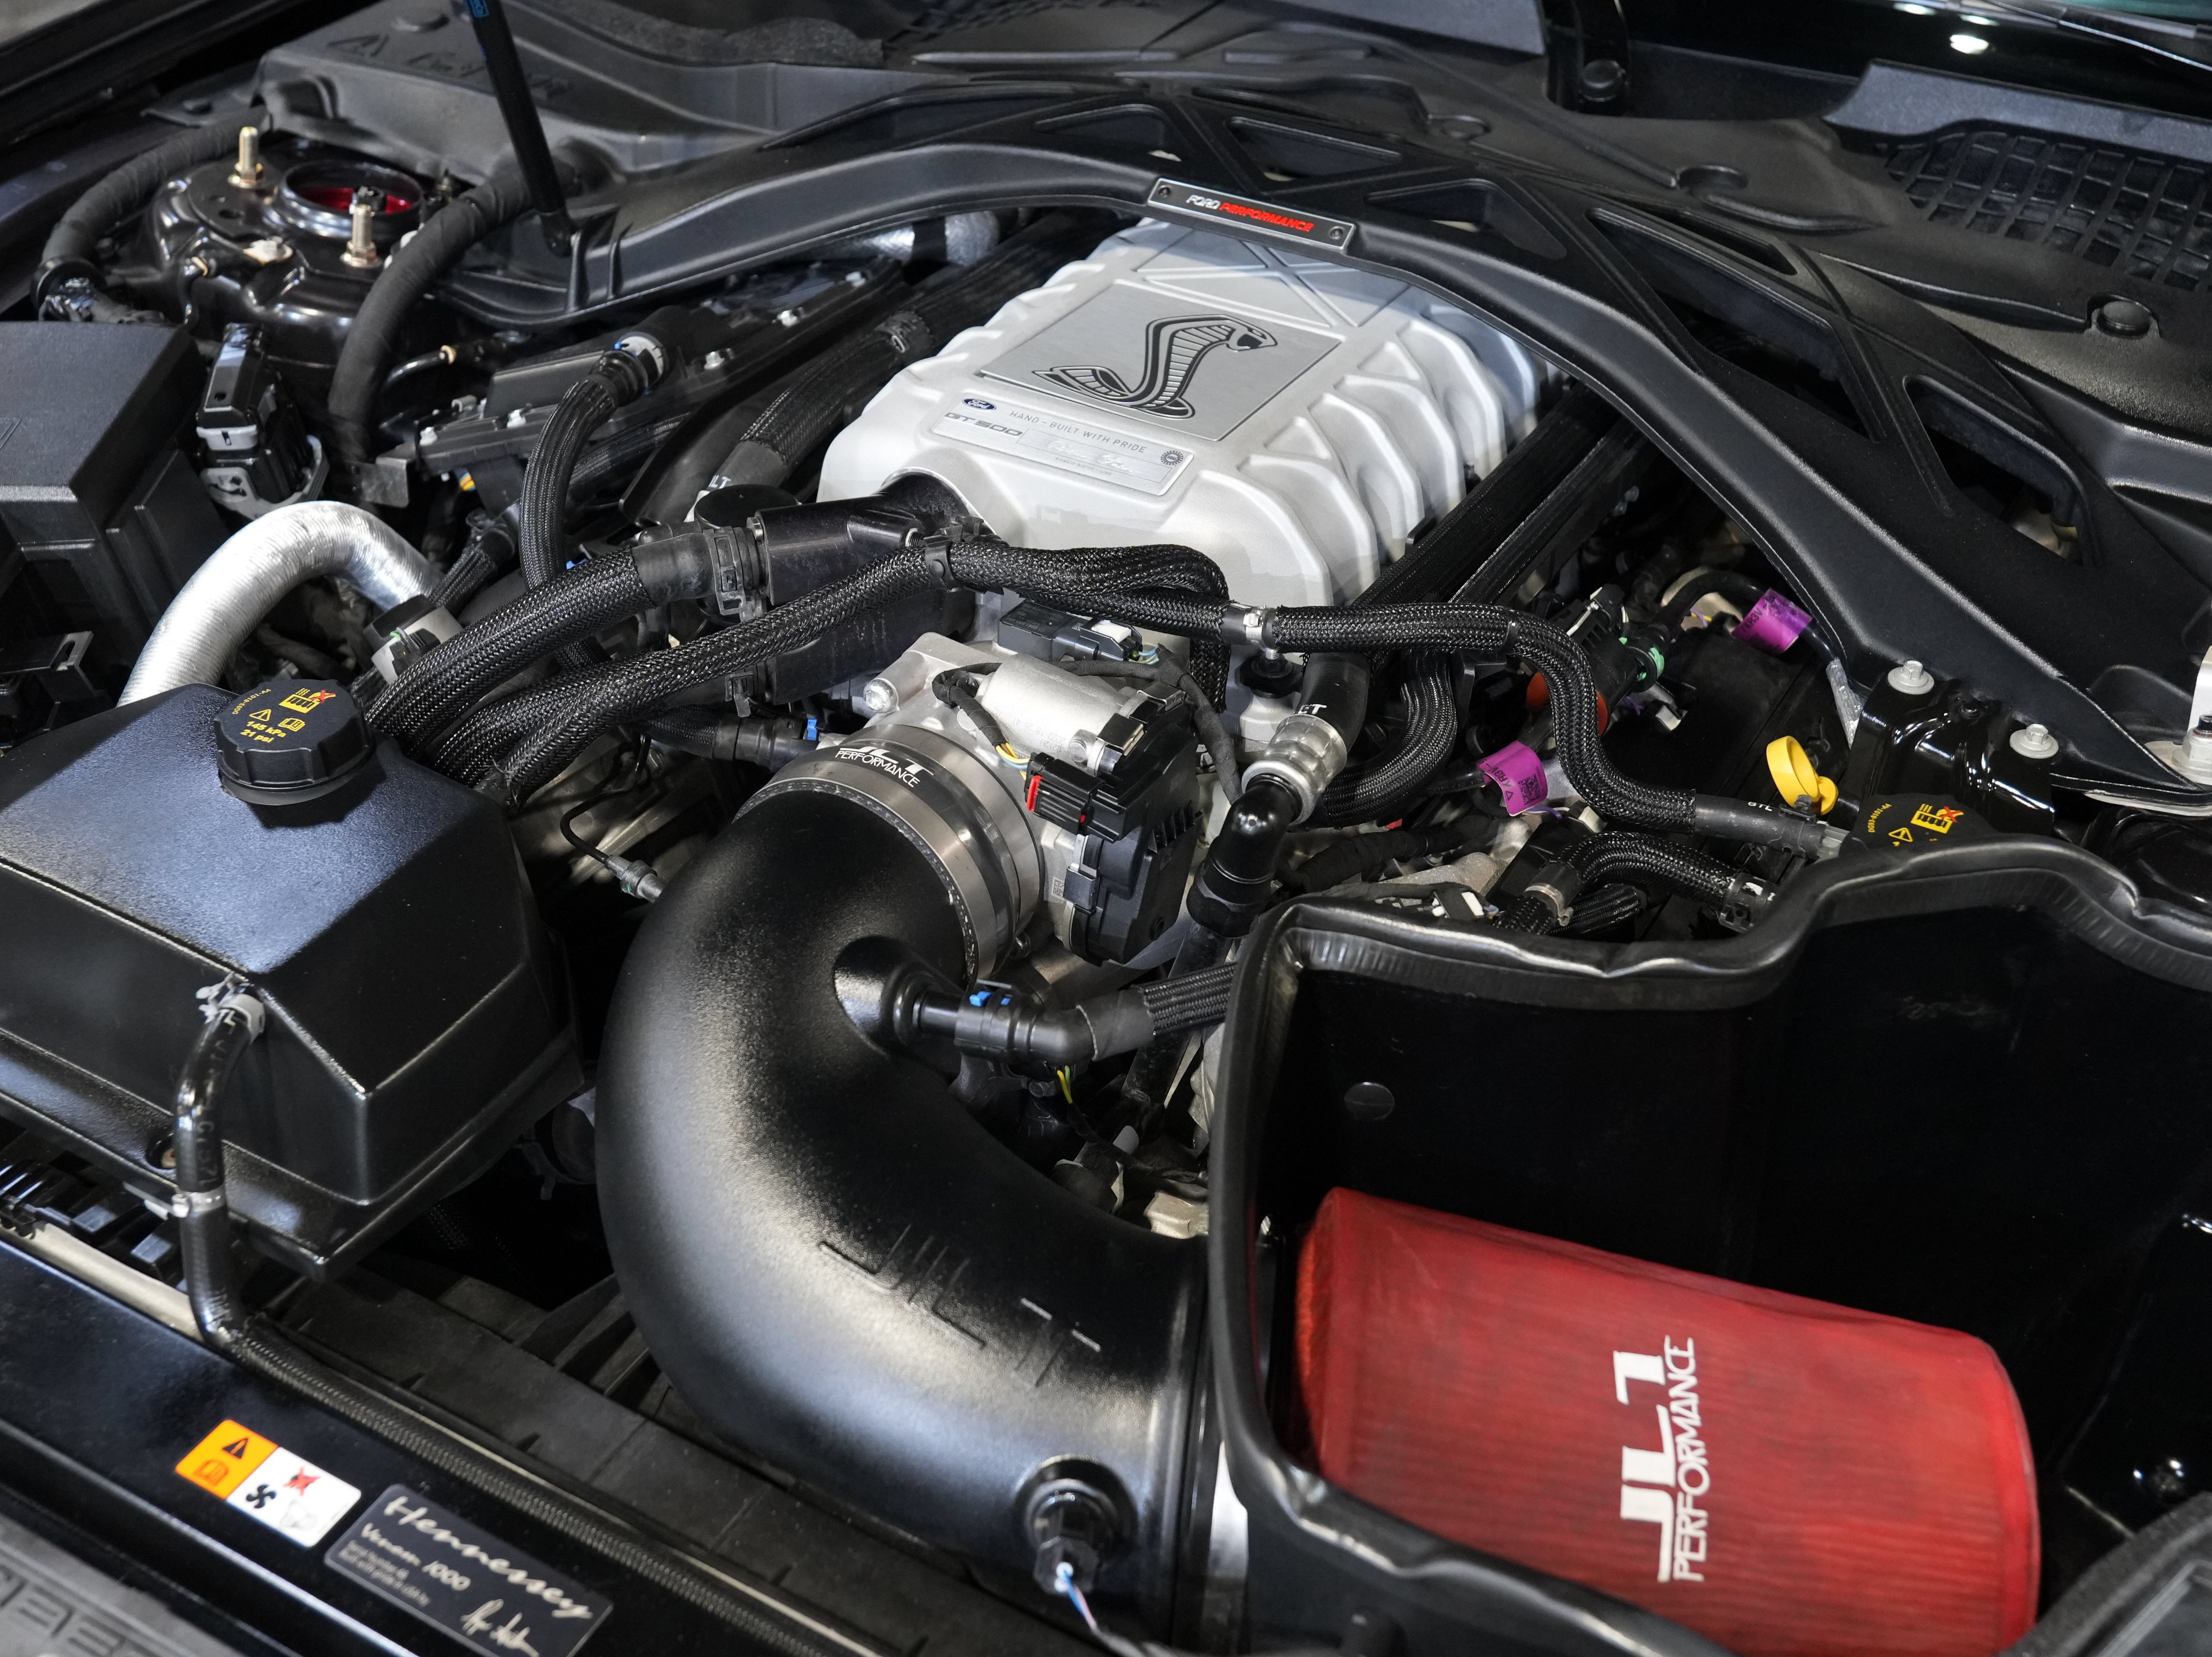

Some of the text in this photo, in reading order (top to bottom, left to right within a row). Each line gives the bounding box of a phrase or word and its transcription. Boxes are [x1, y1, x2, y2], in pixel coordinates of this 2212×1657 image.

[1186, 195, 1315, 232] FORD PERFORMANCE
[964, 399, 993, 410] Ford
[944, 412, 1023, 437] GT 500
[1010, 411, 1039, 424] HAND
[1049, 421, 1079, 434] BUILT
[1083, 431, 1111, 443] WITH
[1113, 439, 1147, 454] PRIDE
[246, 721, 286, 737] 145 kPa
[254, 734, 275, 743] psi
[835, 750, 920, 787] PERFORMANCE
[839, 746, 934, 776] JLT
[1612, 1350, 1676, 1583] JLT
[1663, 1334, 1710, 1583] PERFORMANCE
[384, 1496, 593, 1619] Hennessey
[422, 1561, 471, 1591] 1000
